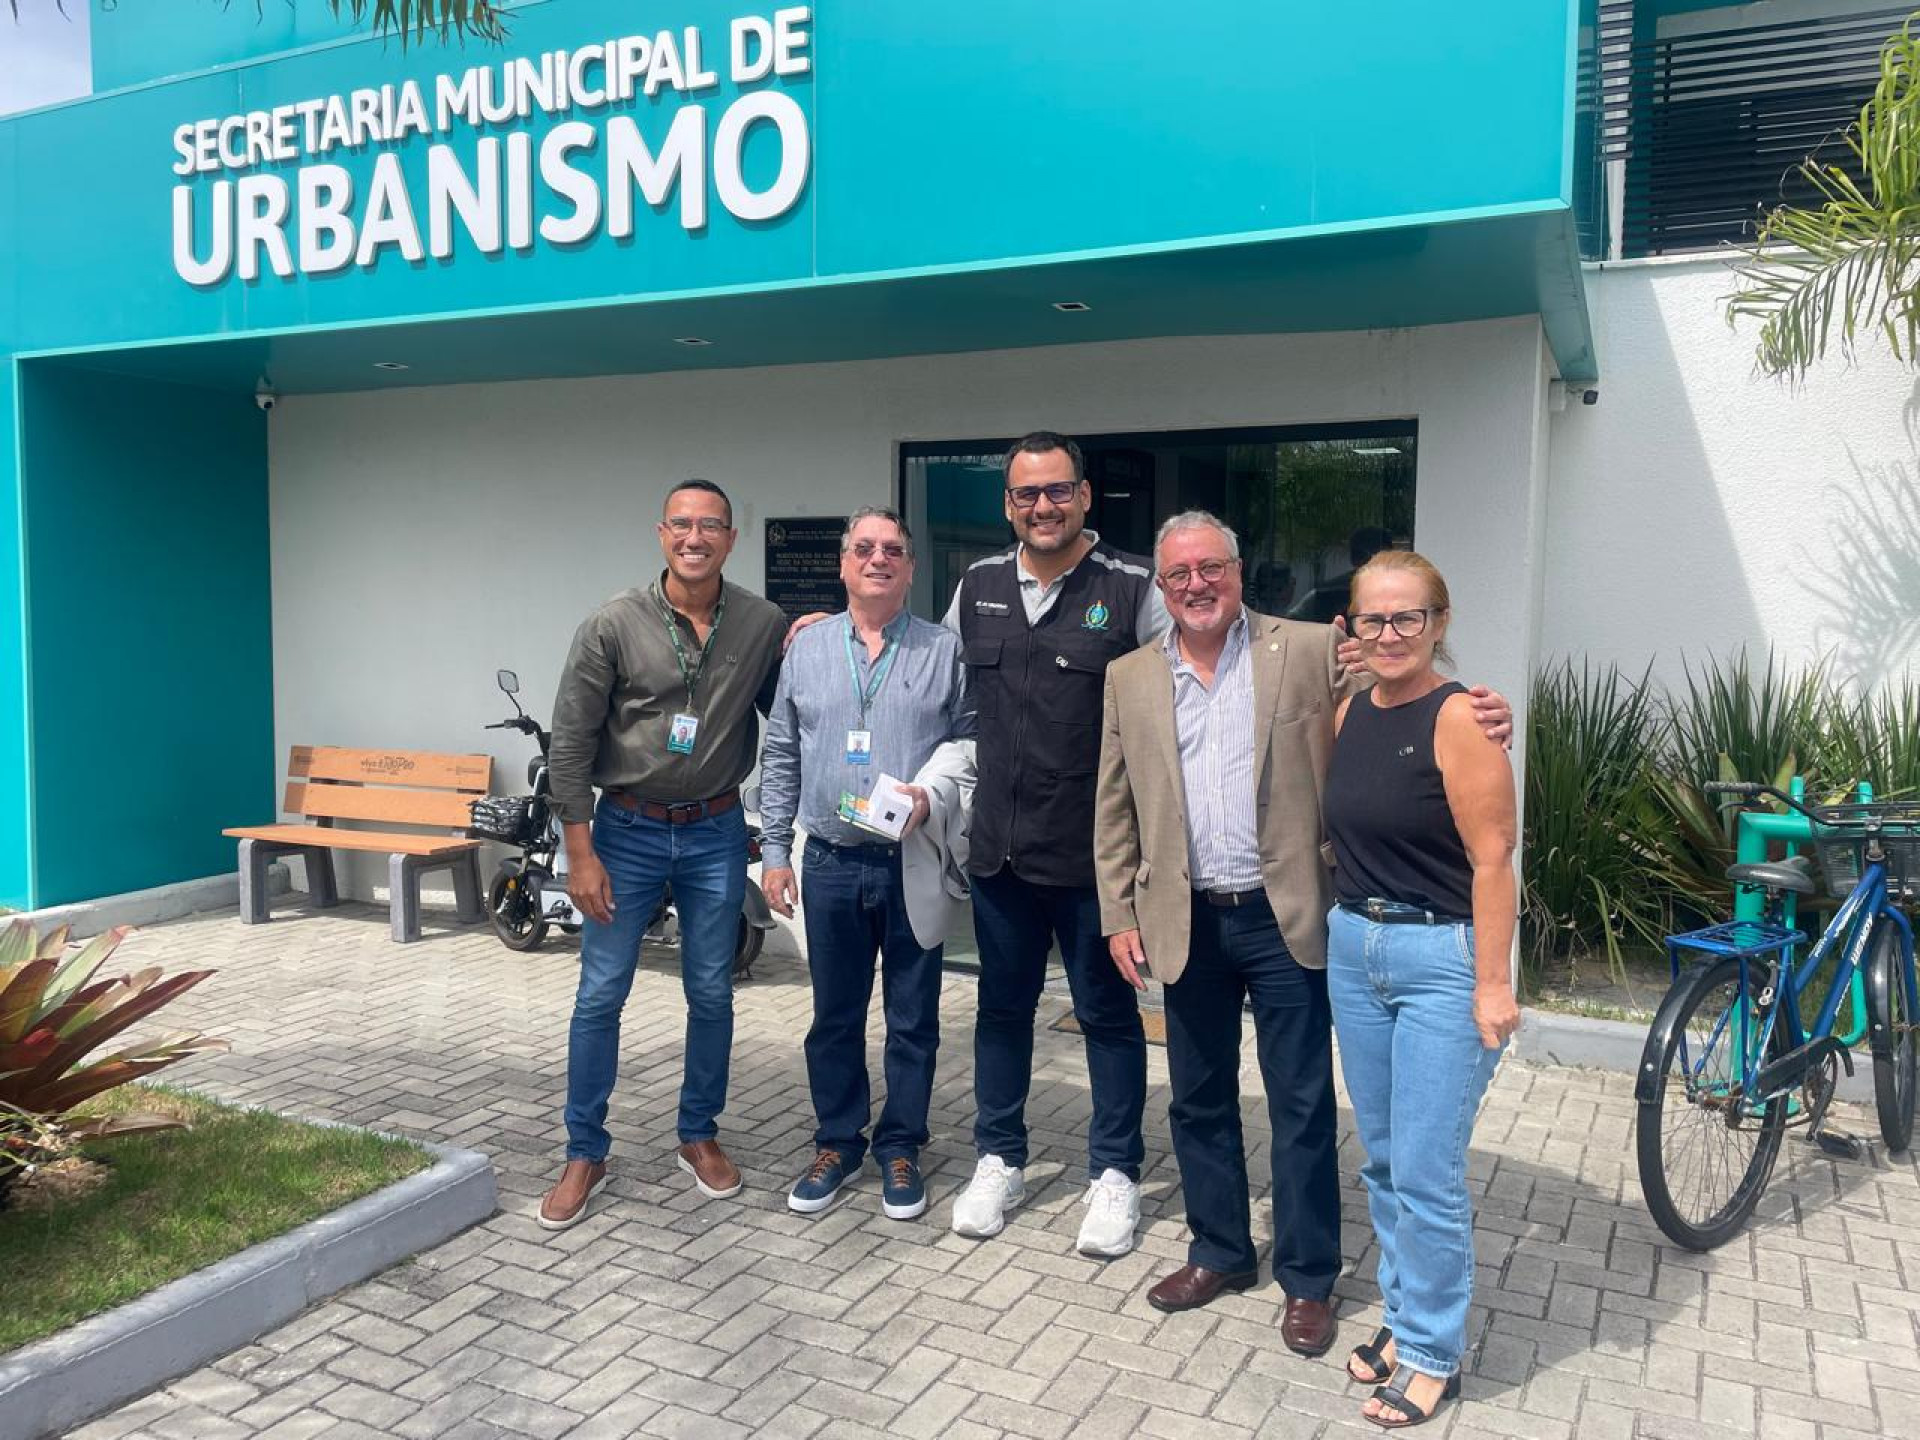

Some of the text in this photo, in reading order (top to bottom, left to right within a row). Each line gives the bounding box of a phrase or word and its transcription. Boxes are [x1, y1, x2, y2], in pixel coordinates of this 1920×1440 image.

[172, 6, 811, 175] SECRETARIA MUNICIPAL DE
[172, 90, 811, 286] URBANISMO
